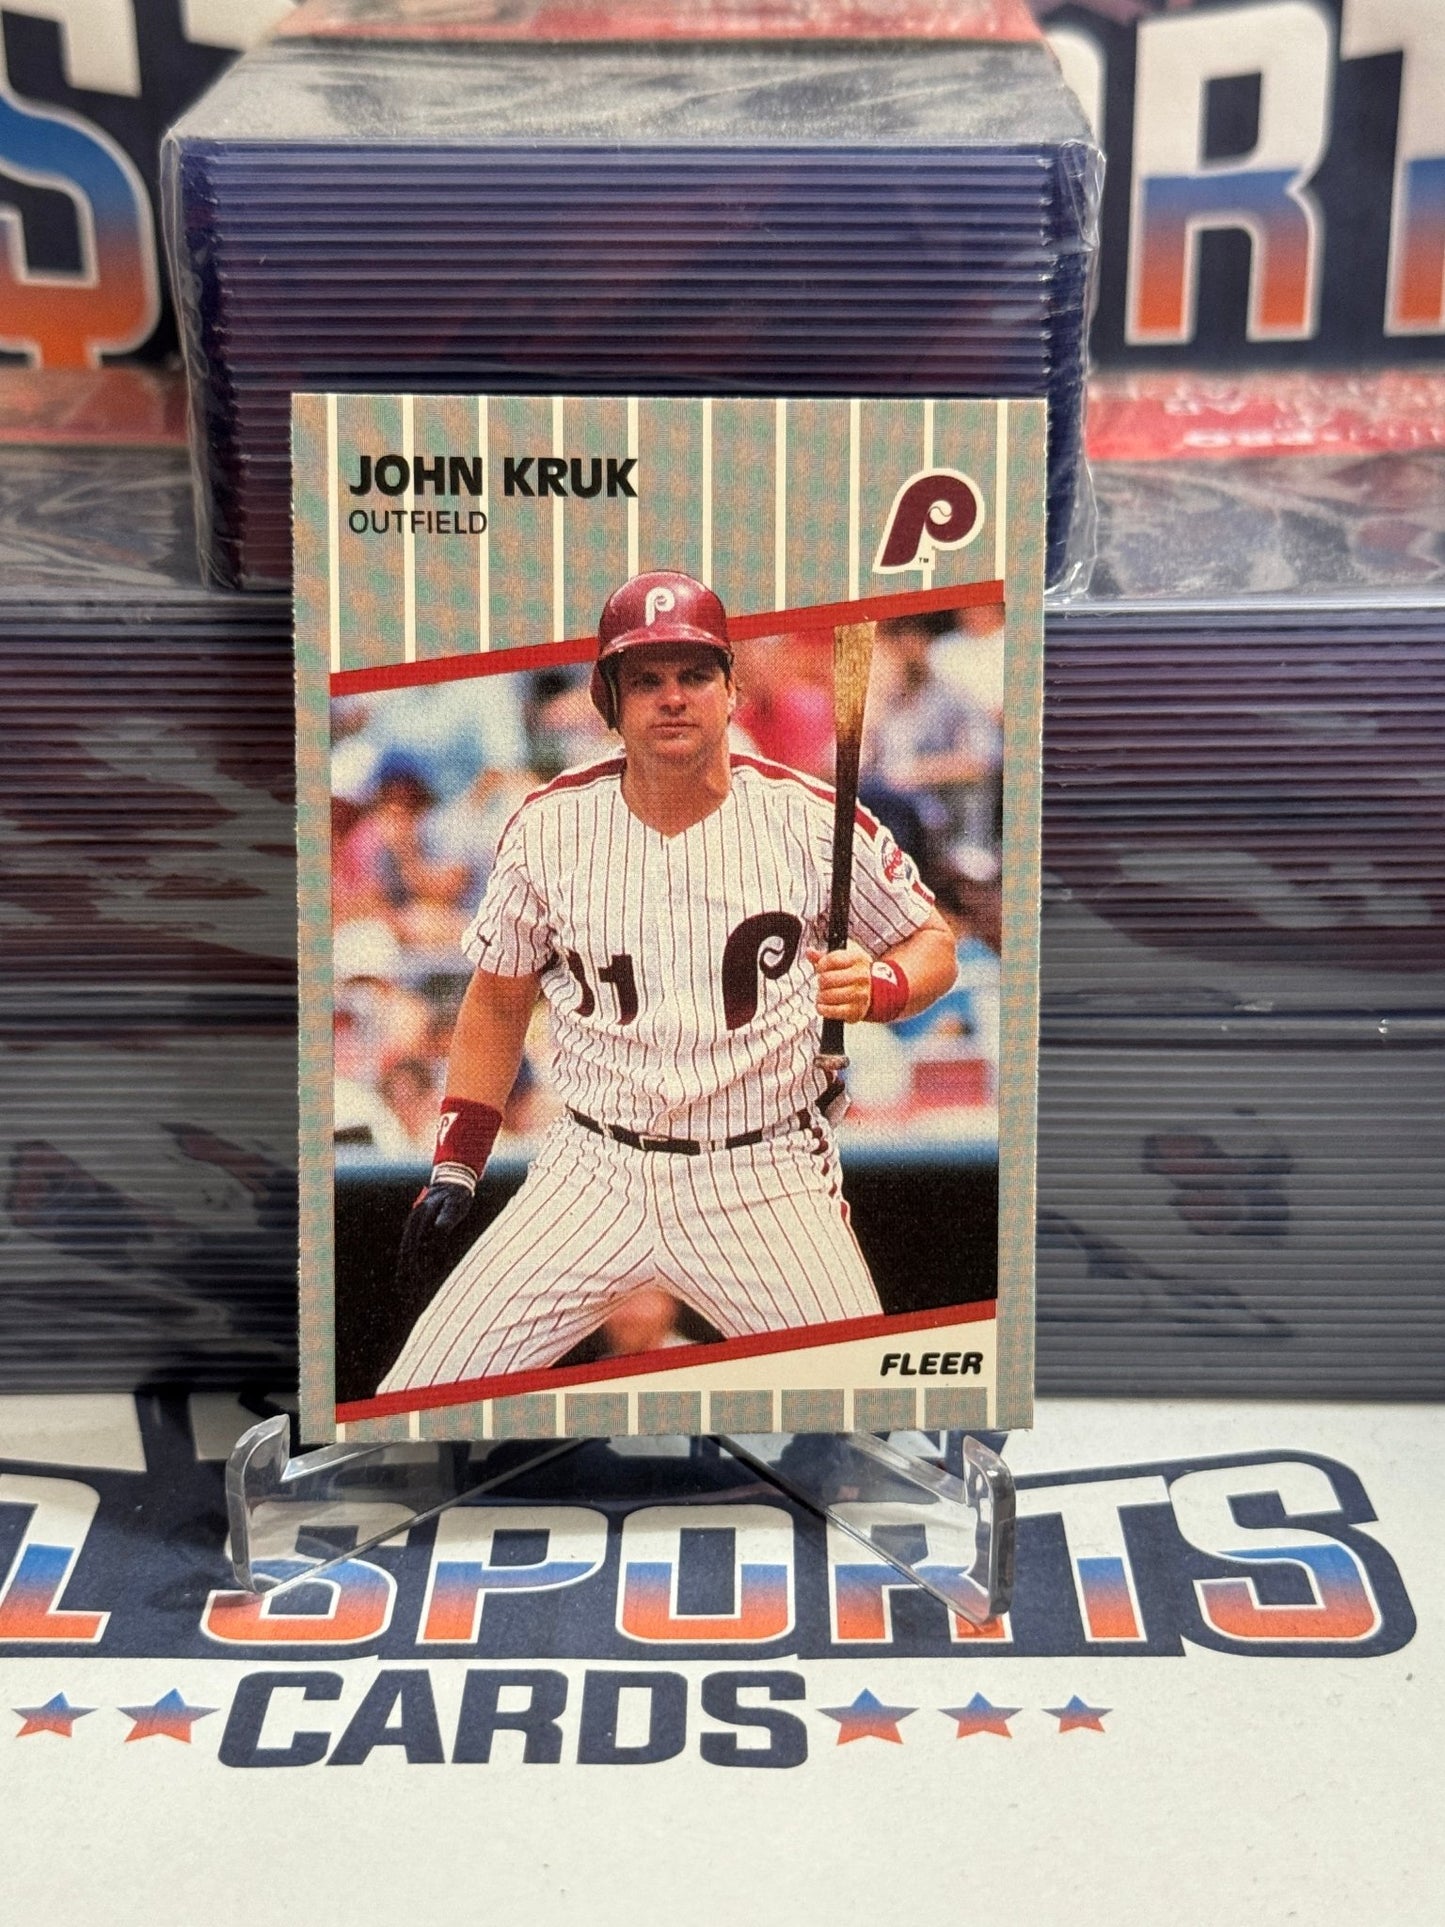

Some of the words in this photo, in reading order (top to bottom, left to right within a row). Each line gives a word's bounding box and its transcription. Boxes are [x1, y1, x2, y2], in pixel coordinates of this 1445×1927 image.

[350, 454, 483, 496] JOHN
[504, 457, 638, 498] KRUK
[349, 509, 487, 534] OUTFIELD
[876, 472, 980, 570] P
[645, 587, 675, 627] P
[722, 911, 801, 1031] P
[880, 1351, 984, 1376] FLEER
[200, 1460, 1384, 1646] SPORTS
[218, 1668, 809, 1769] CARDS
